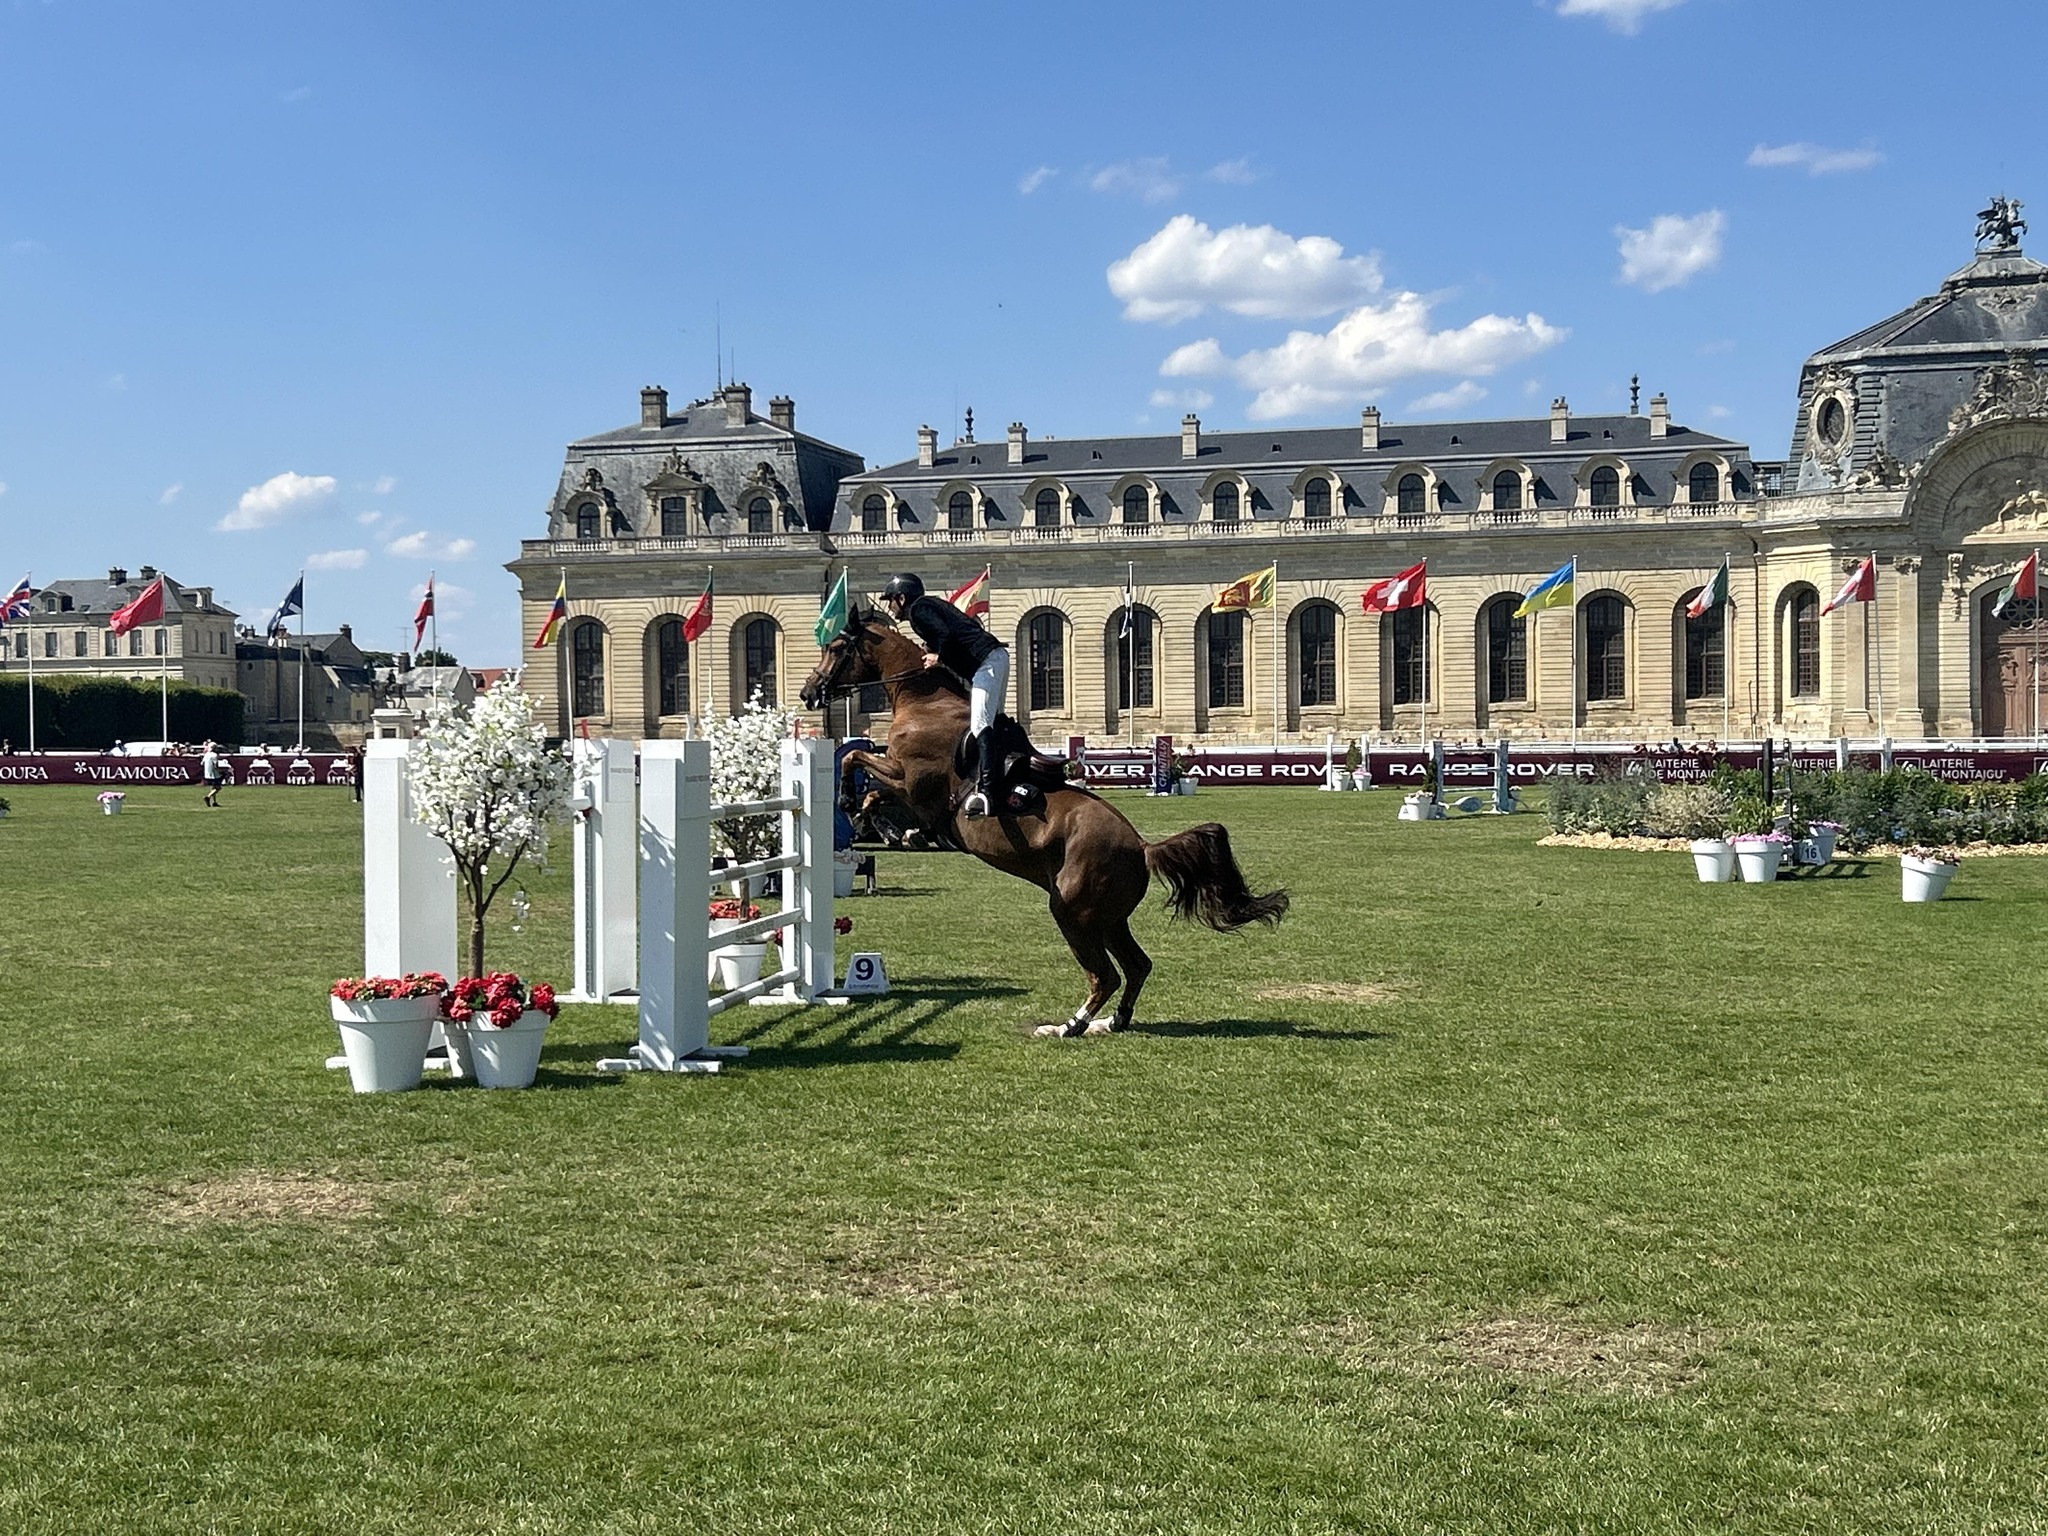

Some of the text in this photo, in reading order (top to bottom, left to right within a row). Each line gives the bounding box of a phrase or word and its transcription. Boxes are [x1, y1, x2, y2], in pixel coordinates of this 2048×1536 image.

[1389, 763, 1596, 776] RAGE ROVER
[1648, 759, 1699, 768] LAITERIE
[1791, 759, 1836, 769] AITERIE
[1922, 758, 1975, 769] LAITERIE
[88, 766, 190, 779] VILAMOURA
[1085, 764, 1146, 778] VER
[1187, 764, 1264, 777] ANGE
[1667, 769, 1718, 779] MONTAIG
[1805, 847, 1817, 859] 16
[855, 957, 875, 981] 9
